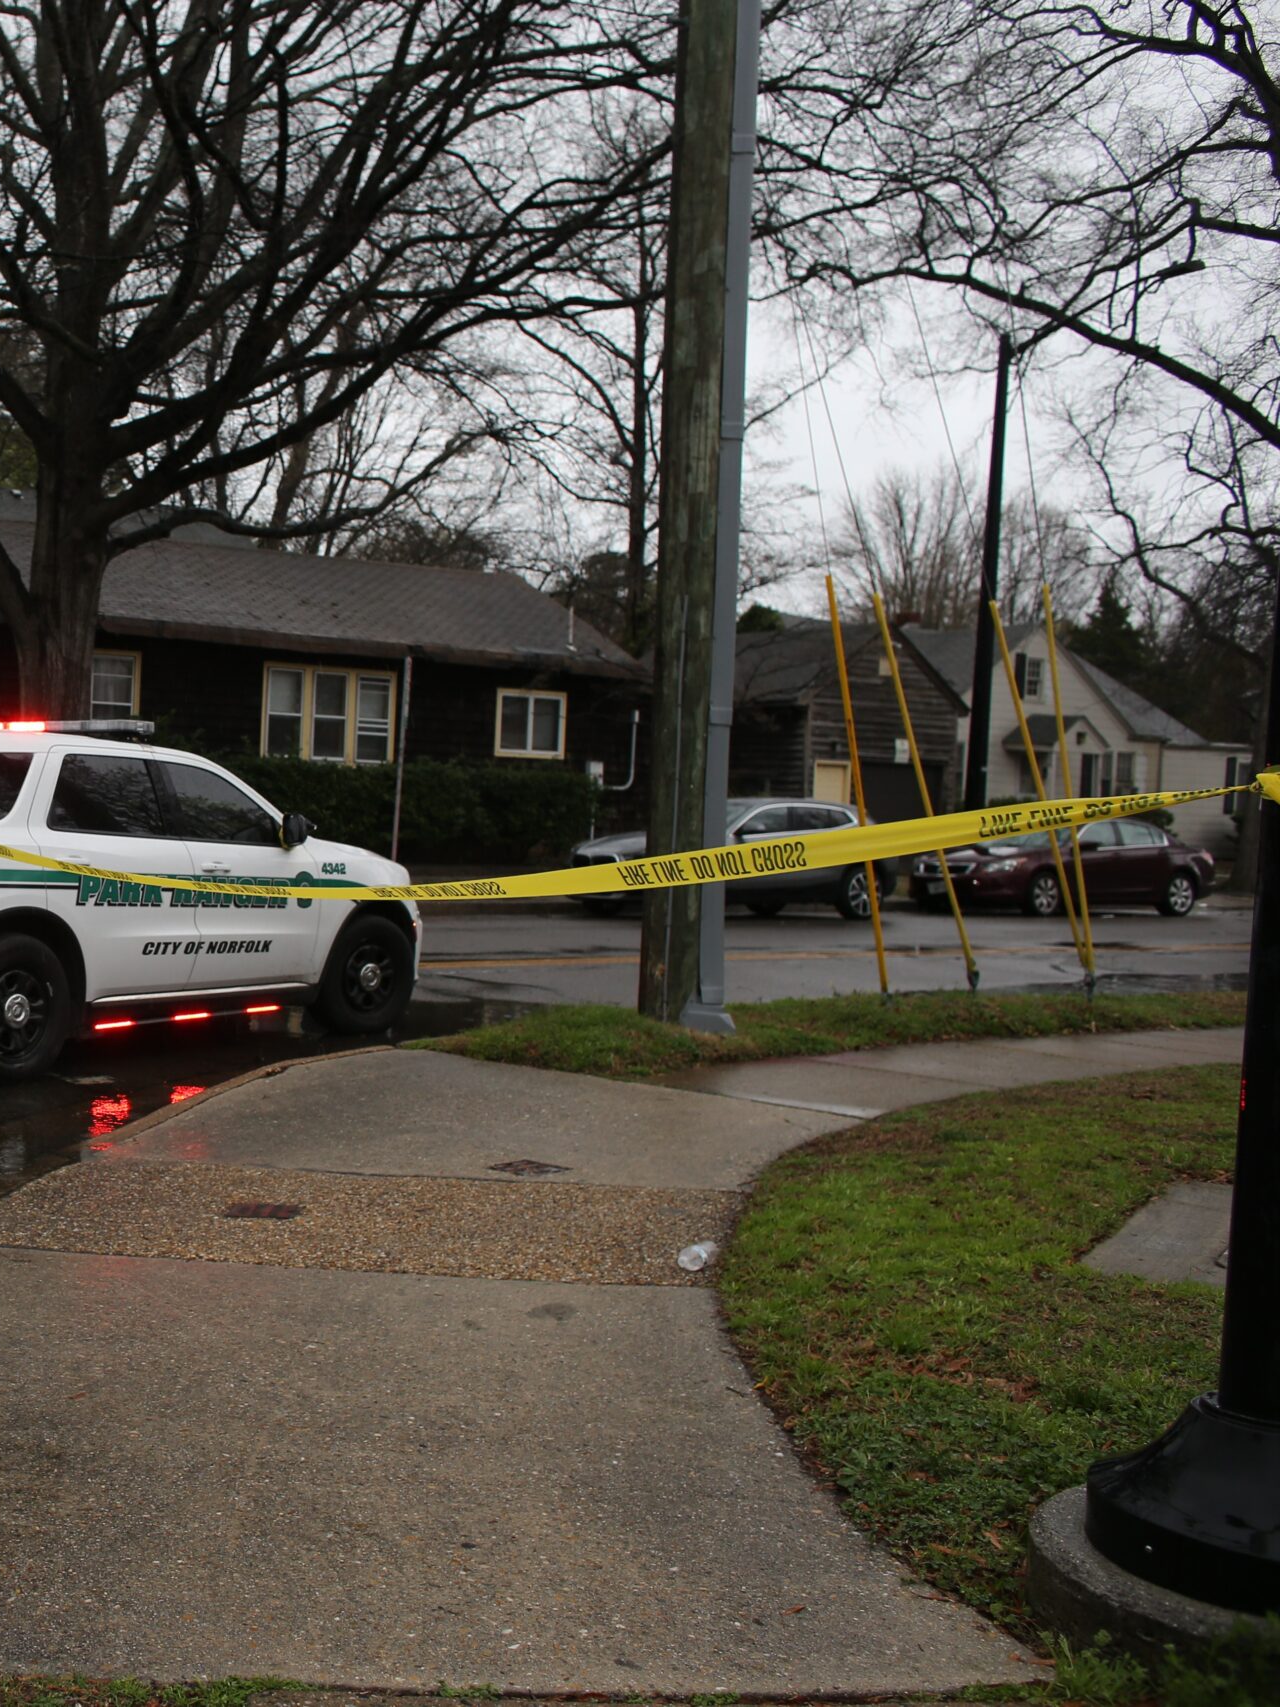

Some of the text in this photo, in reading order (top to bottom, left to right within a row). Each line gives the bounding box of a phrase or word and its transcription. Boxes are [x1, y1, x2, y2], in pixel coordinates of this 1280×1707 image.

[321, 862, 347, 875] 4342
[142, 939, 273, 955] CITY OF NORFOLK
